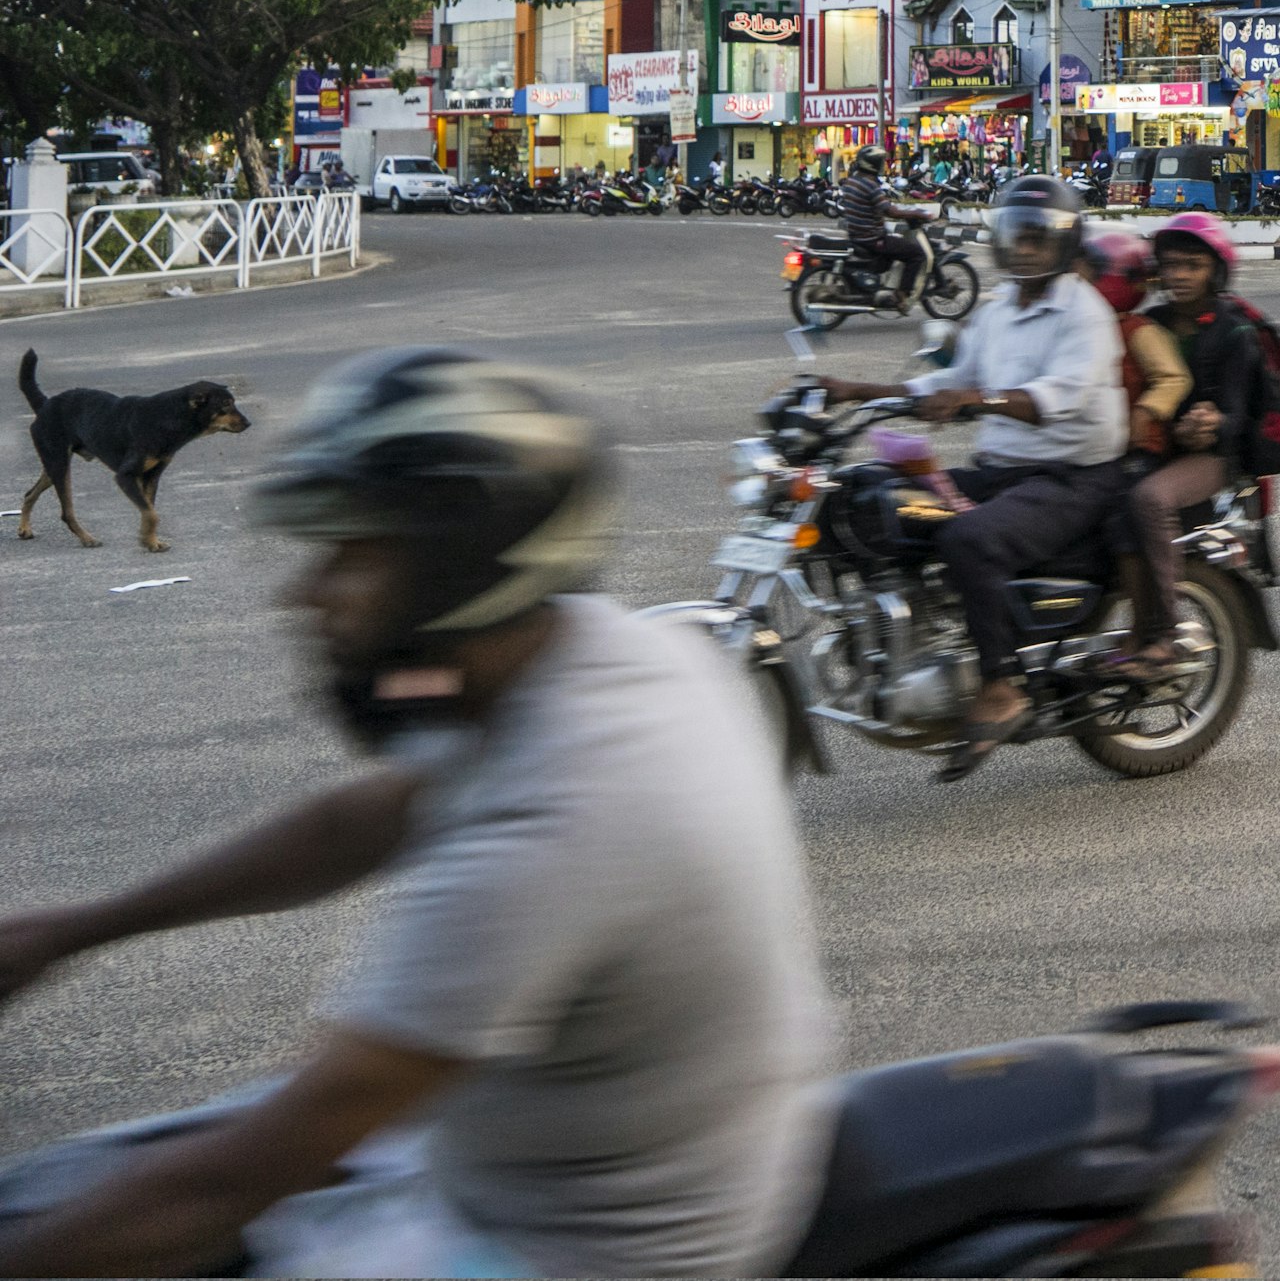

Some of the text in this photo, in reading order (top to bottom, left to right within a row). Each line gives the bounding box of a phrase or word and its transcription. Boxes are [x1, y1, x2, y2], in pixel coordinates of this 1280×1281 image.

[1250, 57, 1279, 73] SIVA
[930, 76, 990, 87] KIDS WORLD
[804, 98, 892, 119] AL MADEENA
